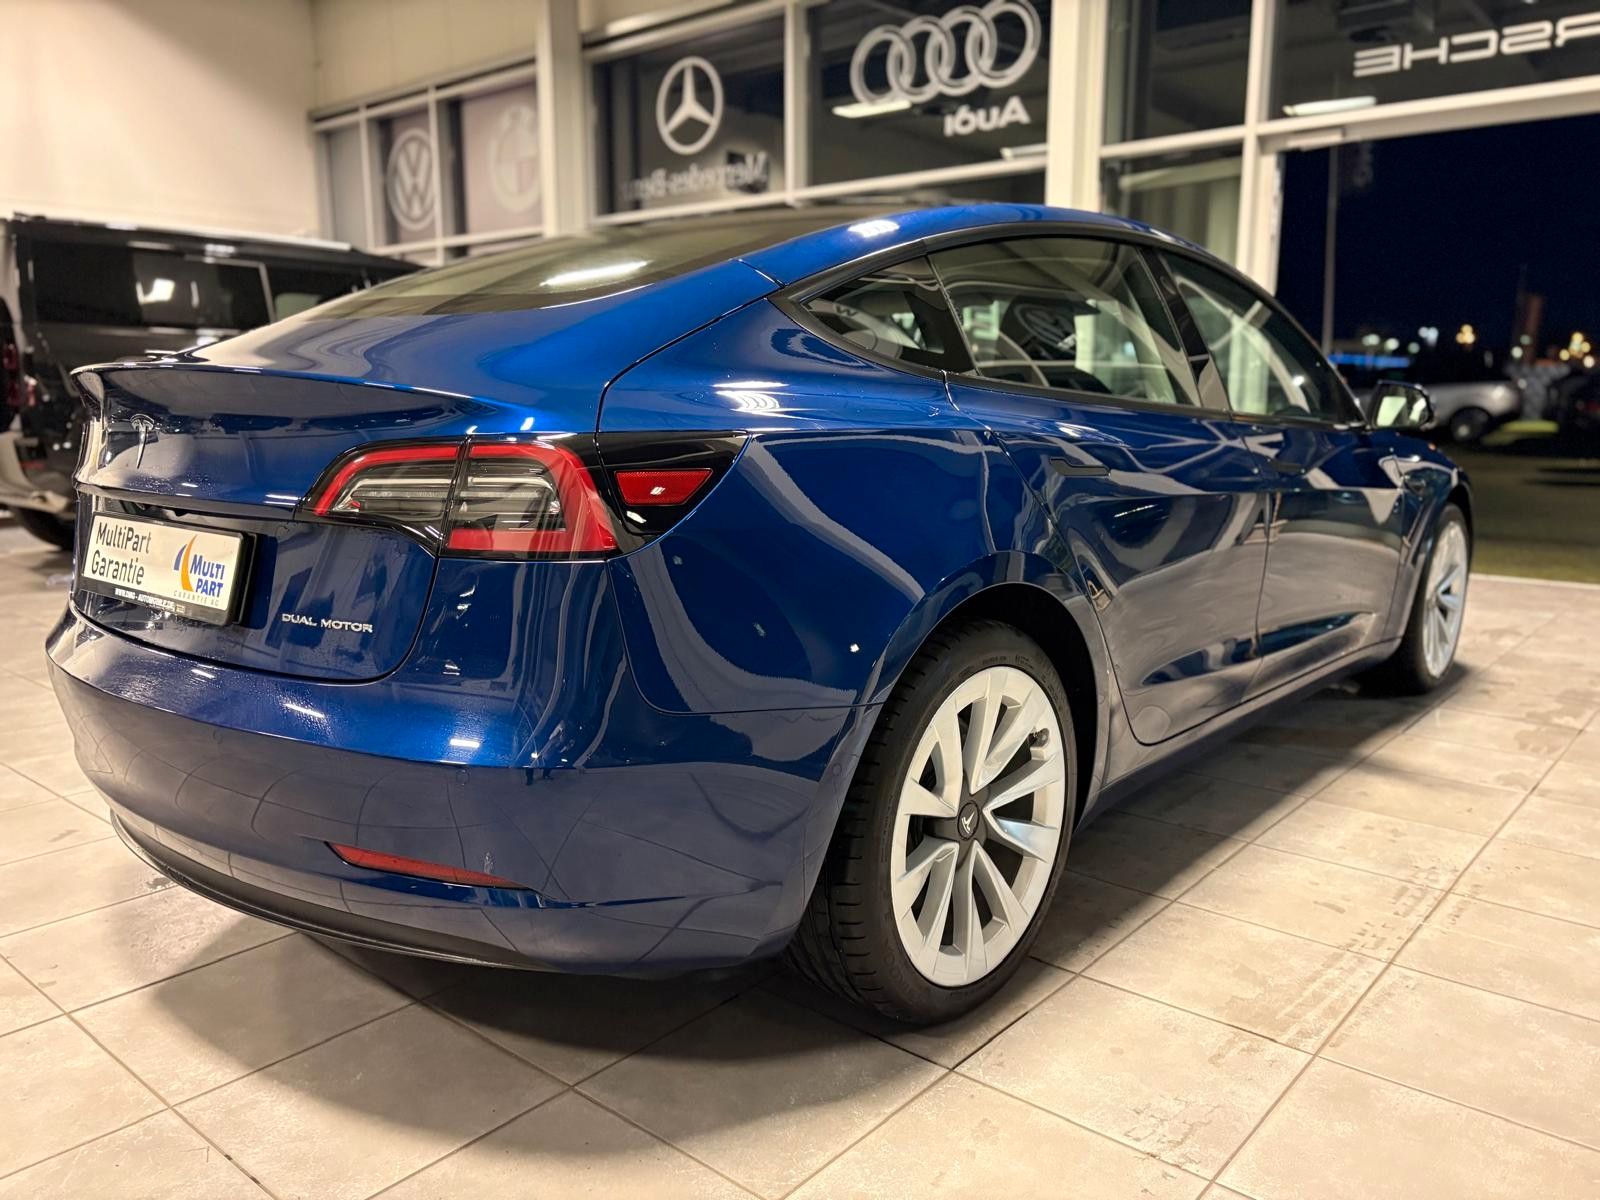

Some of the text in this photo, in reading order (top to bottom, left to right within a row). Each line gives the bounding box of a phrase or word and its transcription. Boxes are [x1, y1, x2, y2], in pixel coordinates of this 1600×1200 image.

[96, 521, 152, 554] MultiPart
[91, 549, 145, 585] Garantie
[195, 578, 224, 598] PART
[281, 613, 373, 633] DUAL MOTOR
